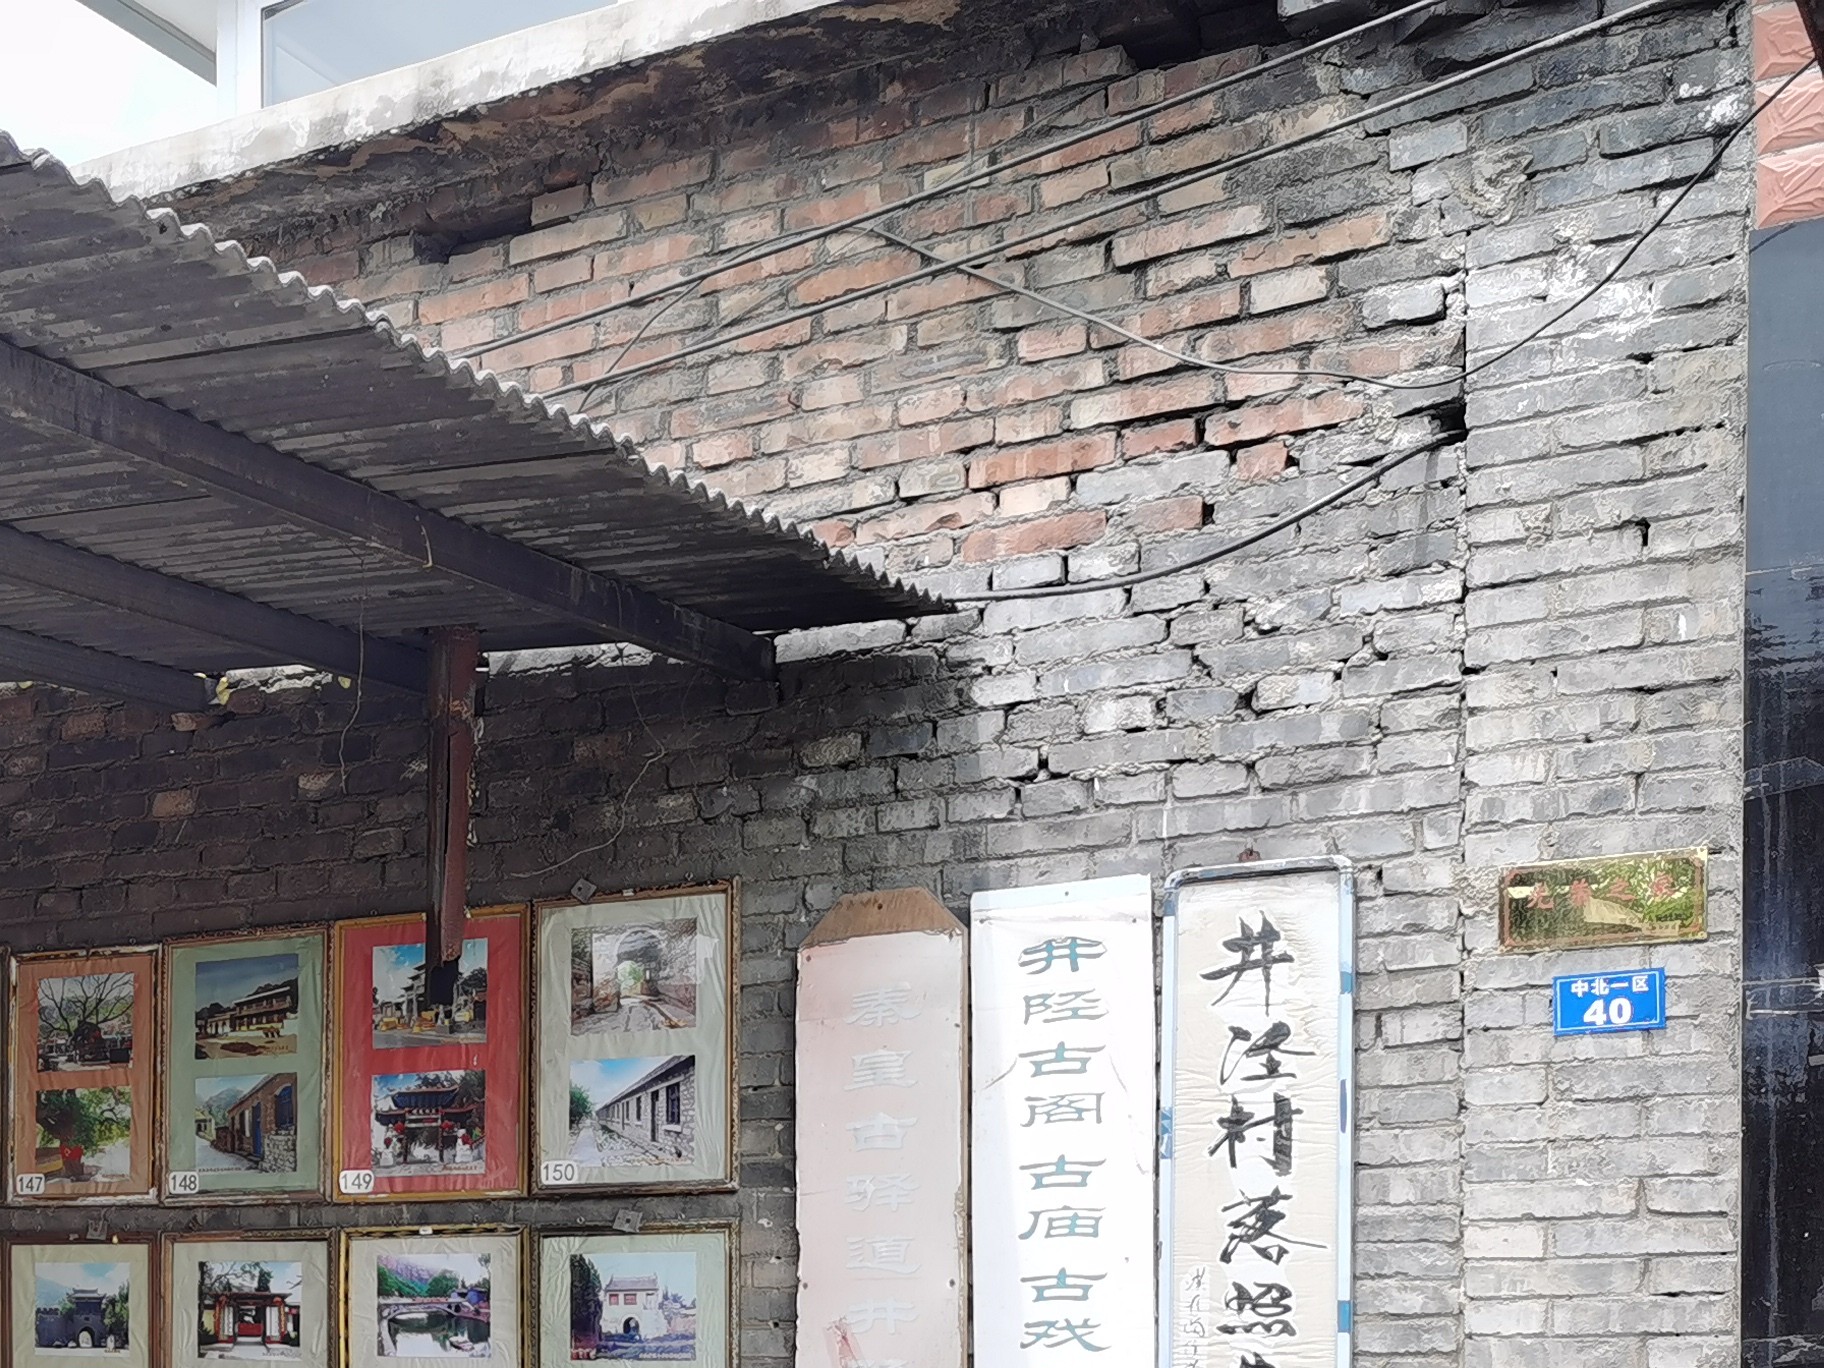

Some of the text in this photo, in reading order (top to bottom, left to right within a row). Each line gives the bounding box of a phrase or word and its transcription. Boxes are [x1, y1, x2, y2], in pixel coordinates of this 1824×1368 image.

[1571, 975, 1649, 997] 中北一区
[1583, 998, 1632, 1025] 40
[543, 1163, 574, 1181] 150
[19, 1177, 43, 1192] 147
[171, 1175, 197, 1191] 148
[343, 1173, 372, 1190] 149
